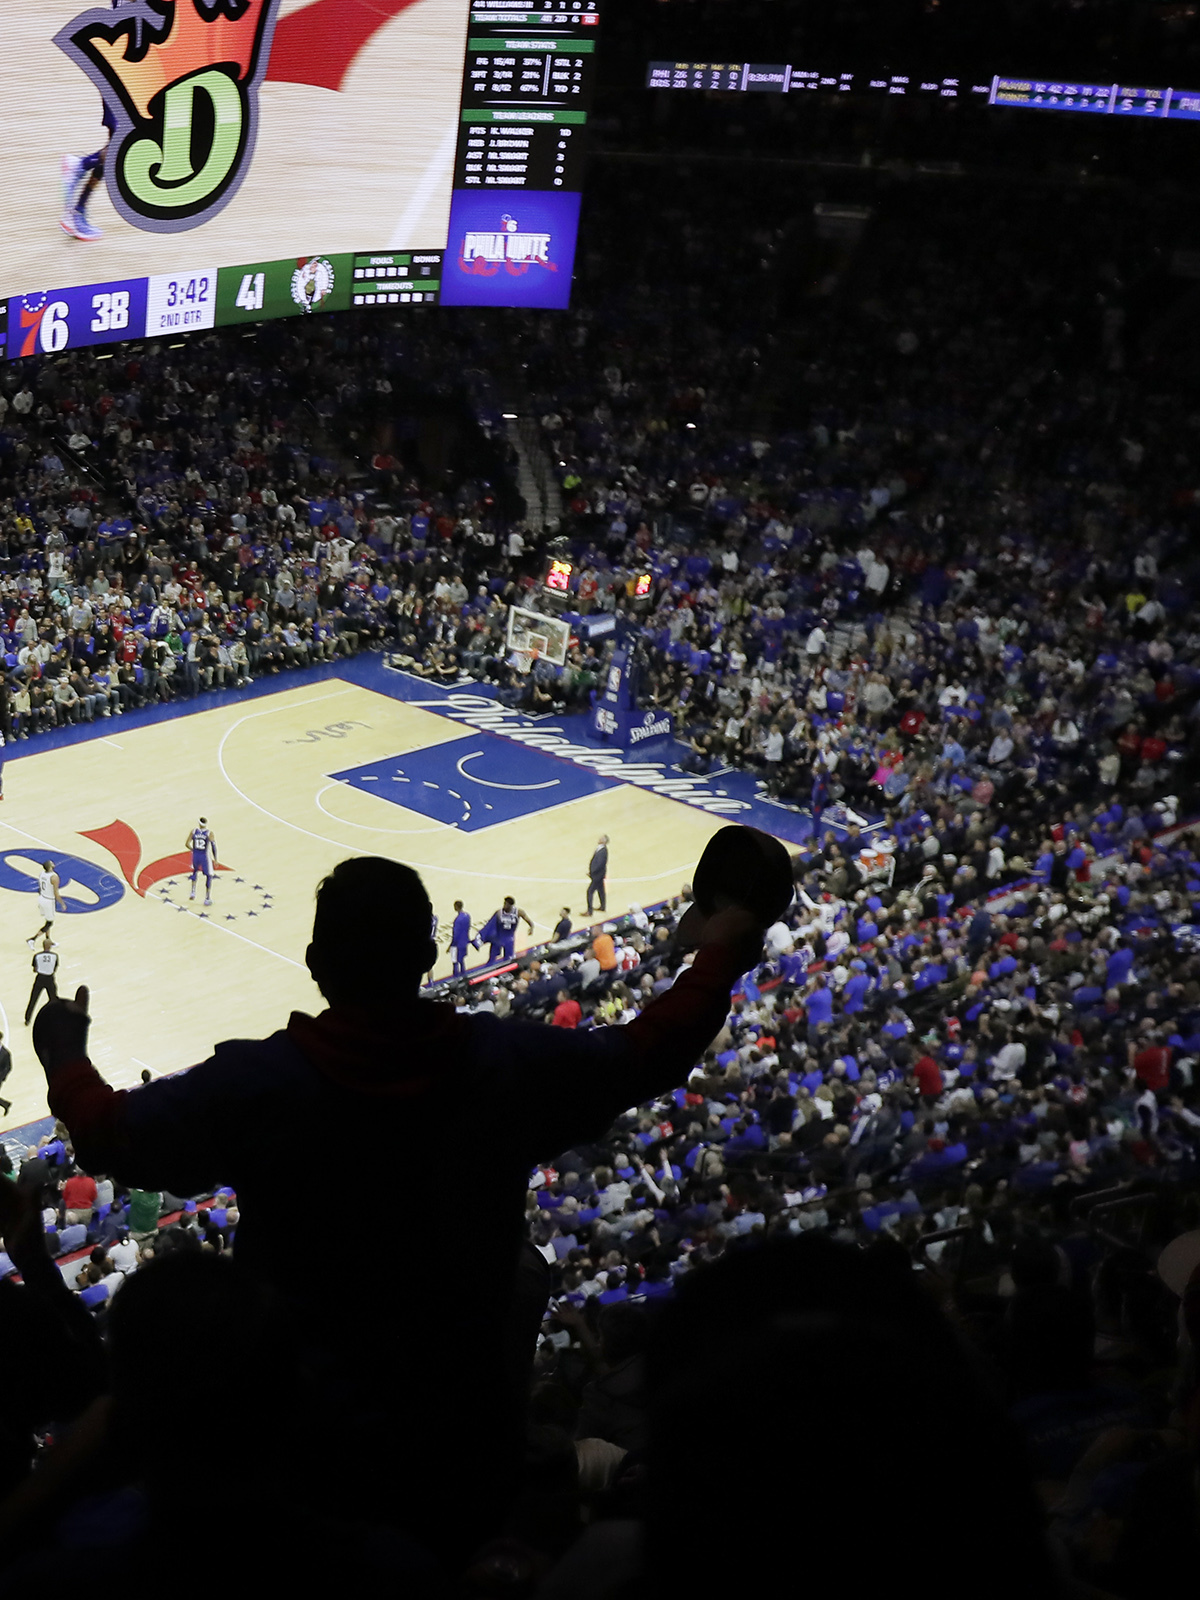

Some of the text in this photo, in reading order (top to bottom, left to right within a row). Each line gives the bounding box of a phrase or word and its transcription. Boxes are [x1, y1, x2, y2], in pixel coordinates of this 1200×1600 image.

[370, 255, 440, 265] FOULS BONUS
[464, 234, 504, 262] PHILA
[167, 277, 208, 307] 3:42
[235, 272, 266, 311] 41
[376, 281, 414, 291] TIMEOUTS
[90, 290, 130, 332] 38
[160, 309, 202, 328] 2ND QTR
[20, 300, 70, 357] 76
[630, 717, 671, 745] SPALDING
[396, 693, 752, 814] Philadelphia
[196, 839, 206, 850] 12
